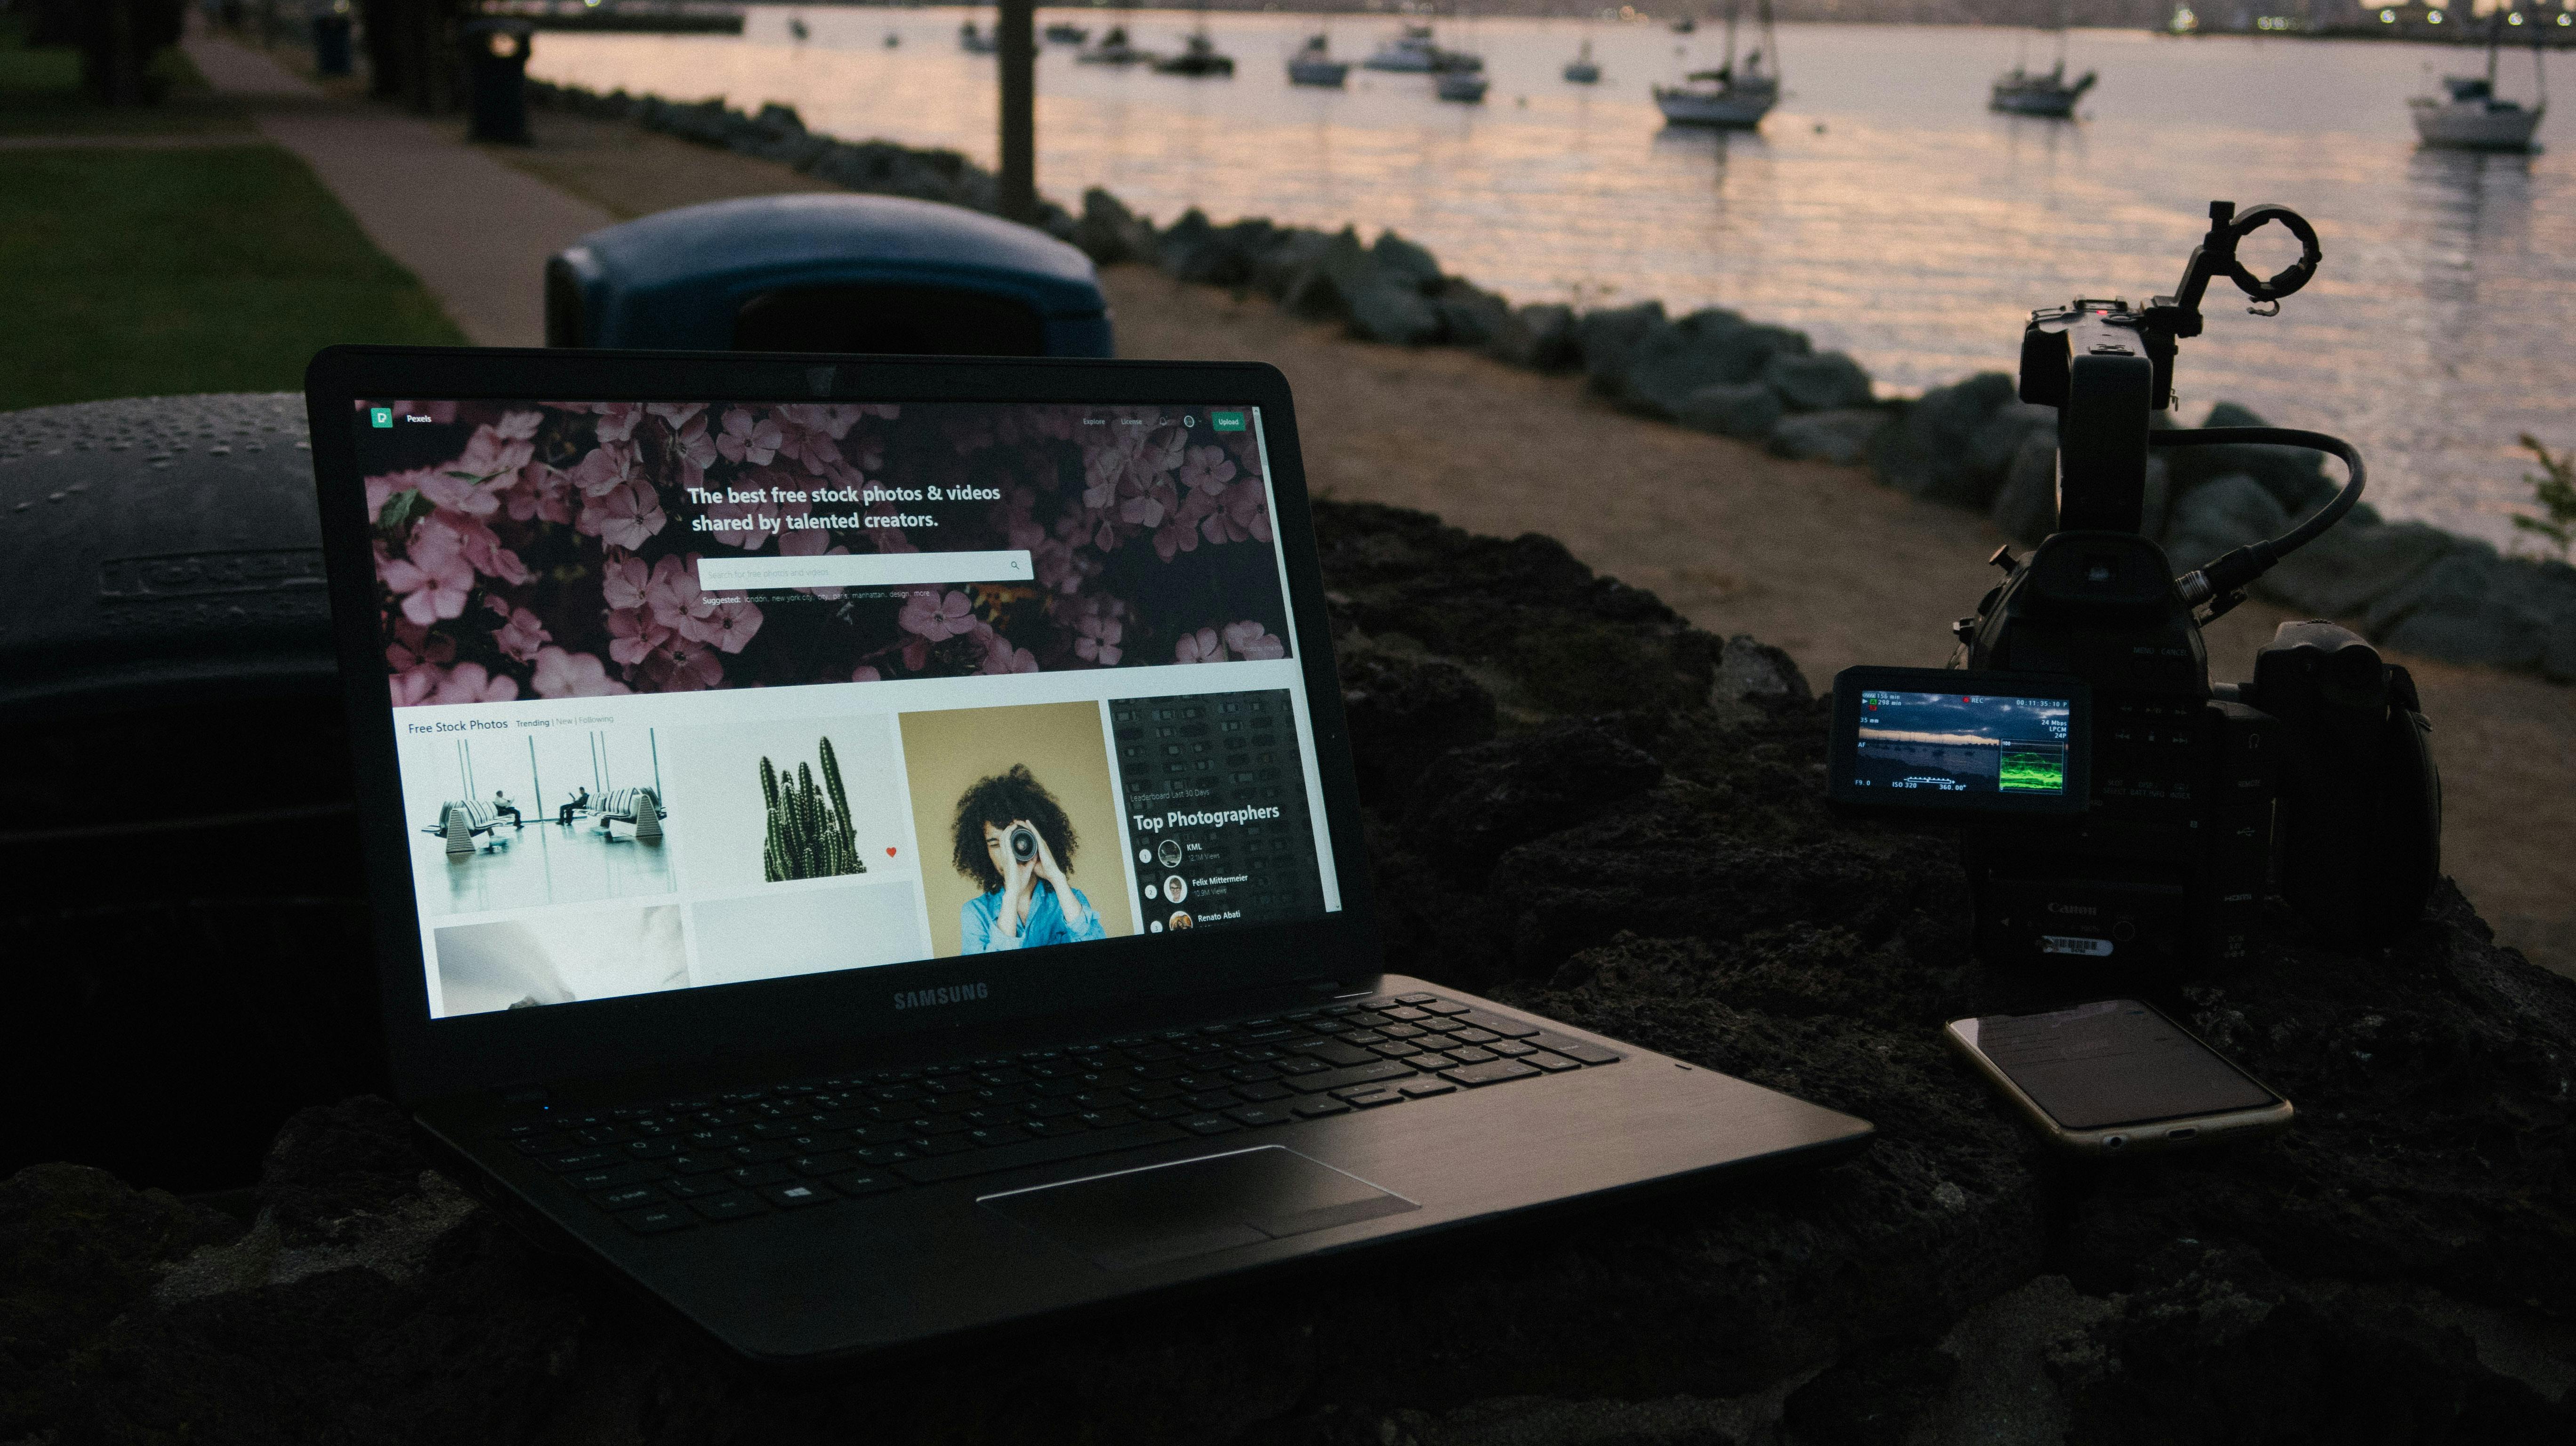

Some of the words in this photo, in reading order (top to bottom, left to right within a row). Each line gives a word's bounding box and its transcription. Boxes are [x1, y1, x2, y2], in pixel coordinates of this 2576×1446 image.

[406, 415, 432, 423] Pexels
[1218, 418, 1239, 426] Upload
[687, 487, 723, 504] The
[727, 487, 767, 503] best
[771, 486, 807, 503] free
[812, 485, 859, 503] stock
[863, 485, 923, 506] photos
[927, 485, 943, 501] &
[946, 484, 1001, 500] videos
[692, 514, 754, 531] shared
[758, 513, 781, 535] by
[785, 512, 859, 530] talented
[864, 513, 939, 528] creators.
[702, 596, 741, 606] Suggested:
[787, 594, 801, 602] york
[2016, 699, 2060, 707] 00:11:35:10
[408, 723, 433, 734] Free
[436, 721, 467, 732] Stock
[470, 719, 508, 730] Photos
[516, 719, 550, 728] Trending
[578, 716, 614, 725] Following
[1130, 792, 1170, 802] Leaderboard
[1195, 789, 1210, 798] Days
[1134, 815, 1163, 833] Top
[1167, 804, 1280, 828] Photographers
[1186, 843, 1203, 851] KML
[1192, 877, 1208, 887] Felix
[1209, 874, 1248, 885] Mittermeier
[2047, 901, 2097, 916] Canon
[1198, 913, 1222, 923] Renato
[1224, 910, 1241, 920] Abati
[894, 982, 988, 1010] SAMSUNG
